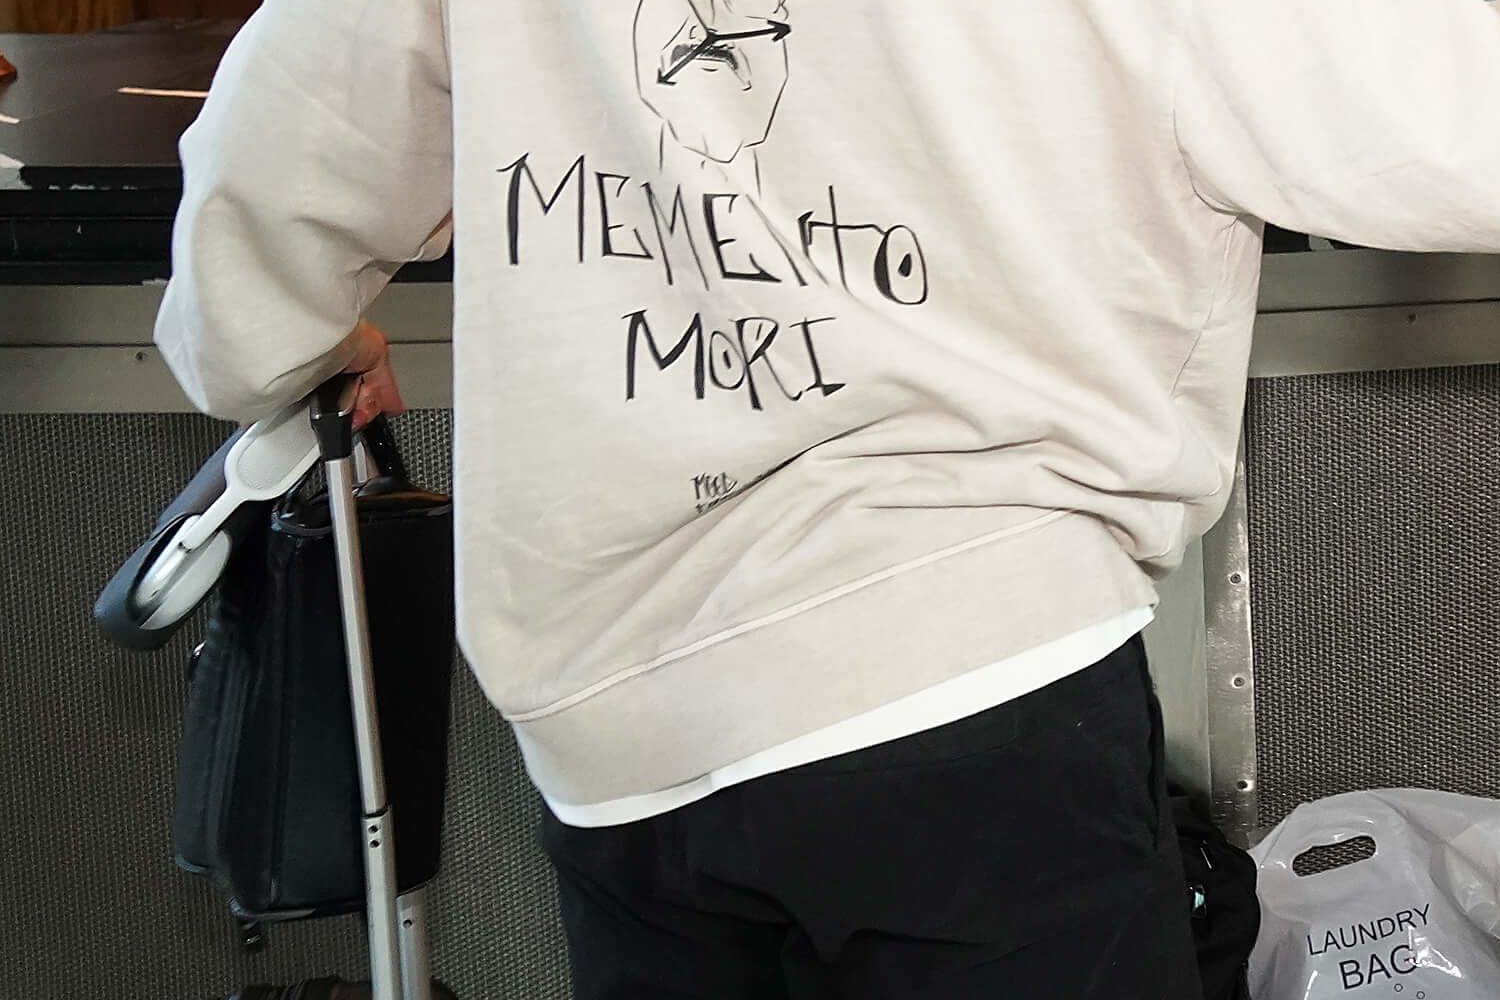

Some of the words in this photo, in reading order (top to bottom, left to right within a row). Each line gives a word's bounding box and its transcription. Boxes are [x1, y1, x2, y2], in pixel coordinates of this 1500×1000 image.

[622, 309, 847, 411] MORI
[1307, 903, 1429, 955] LAUNDRY
[1339, 944, 1417, 990] BAG
